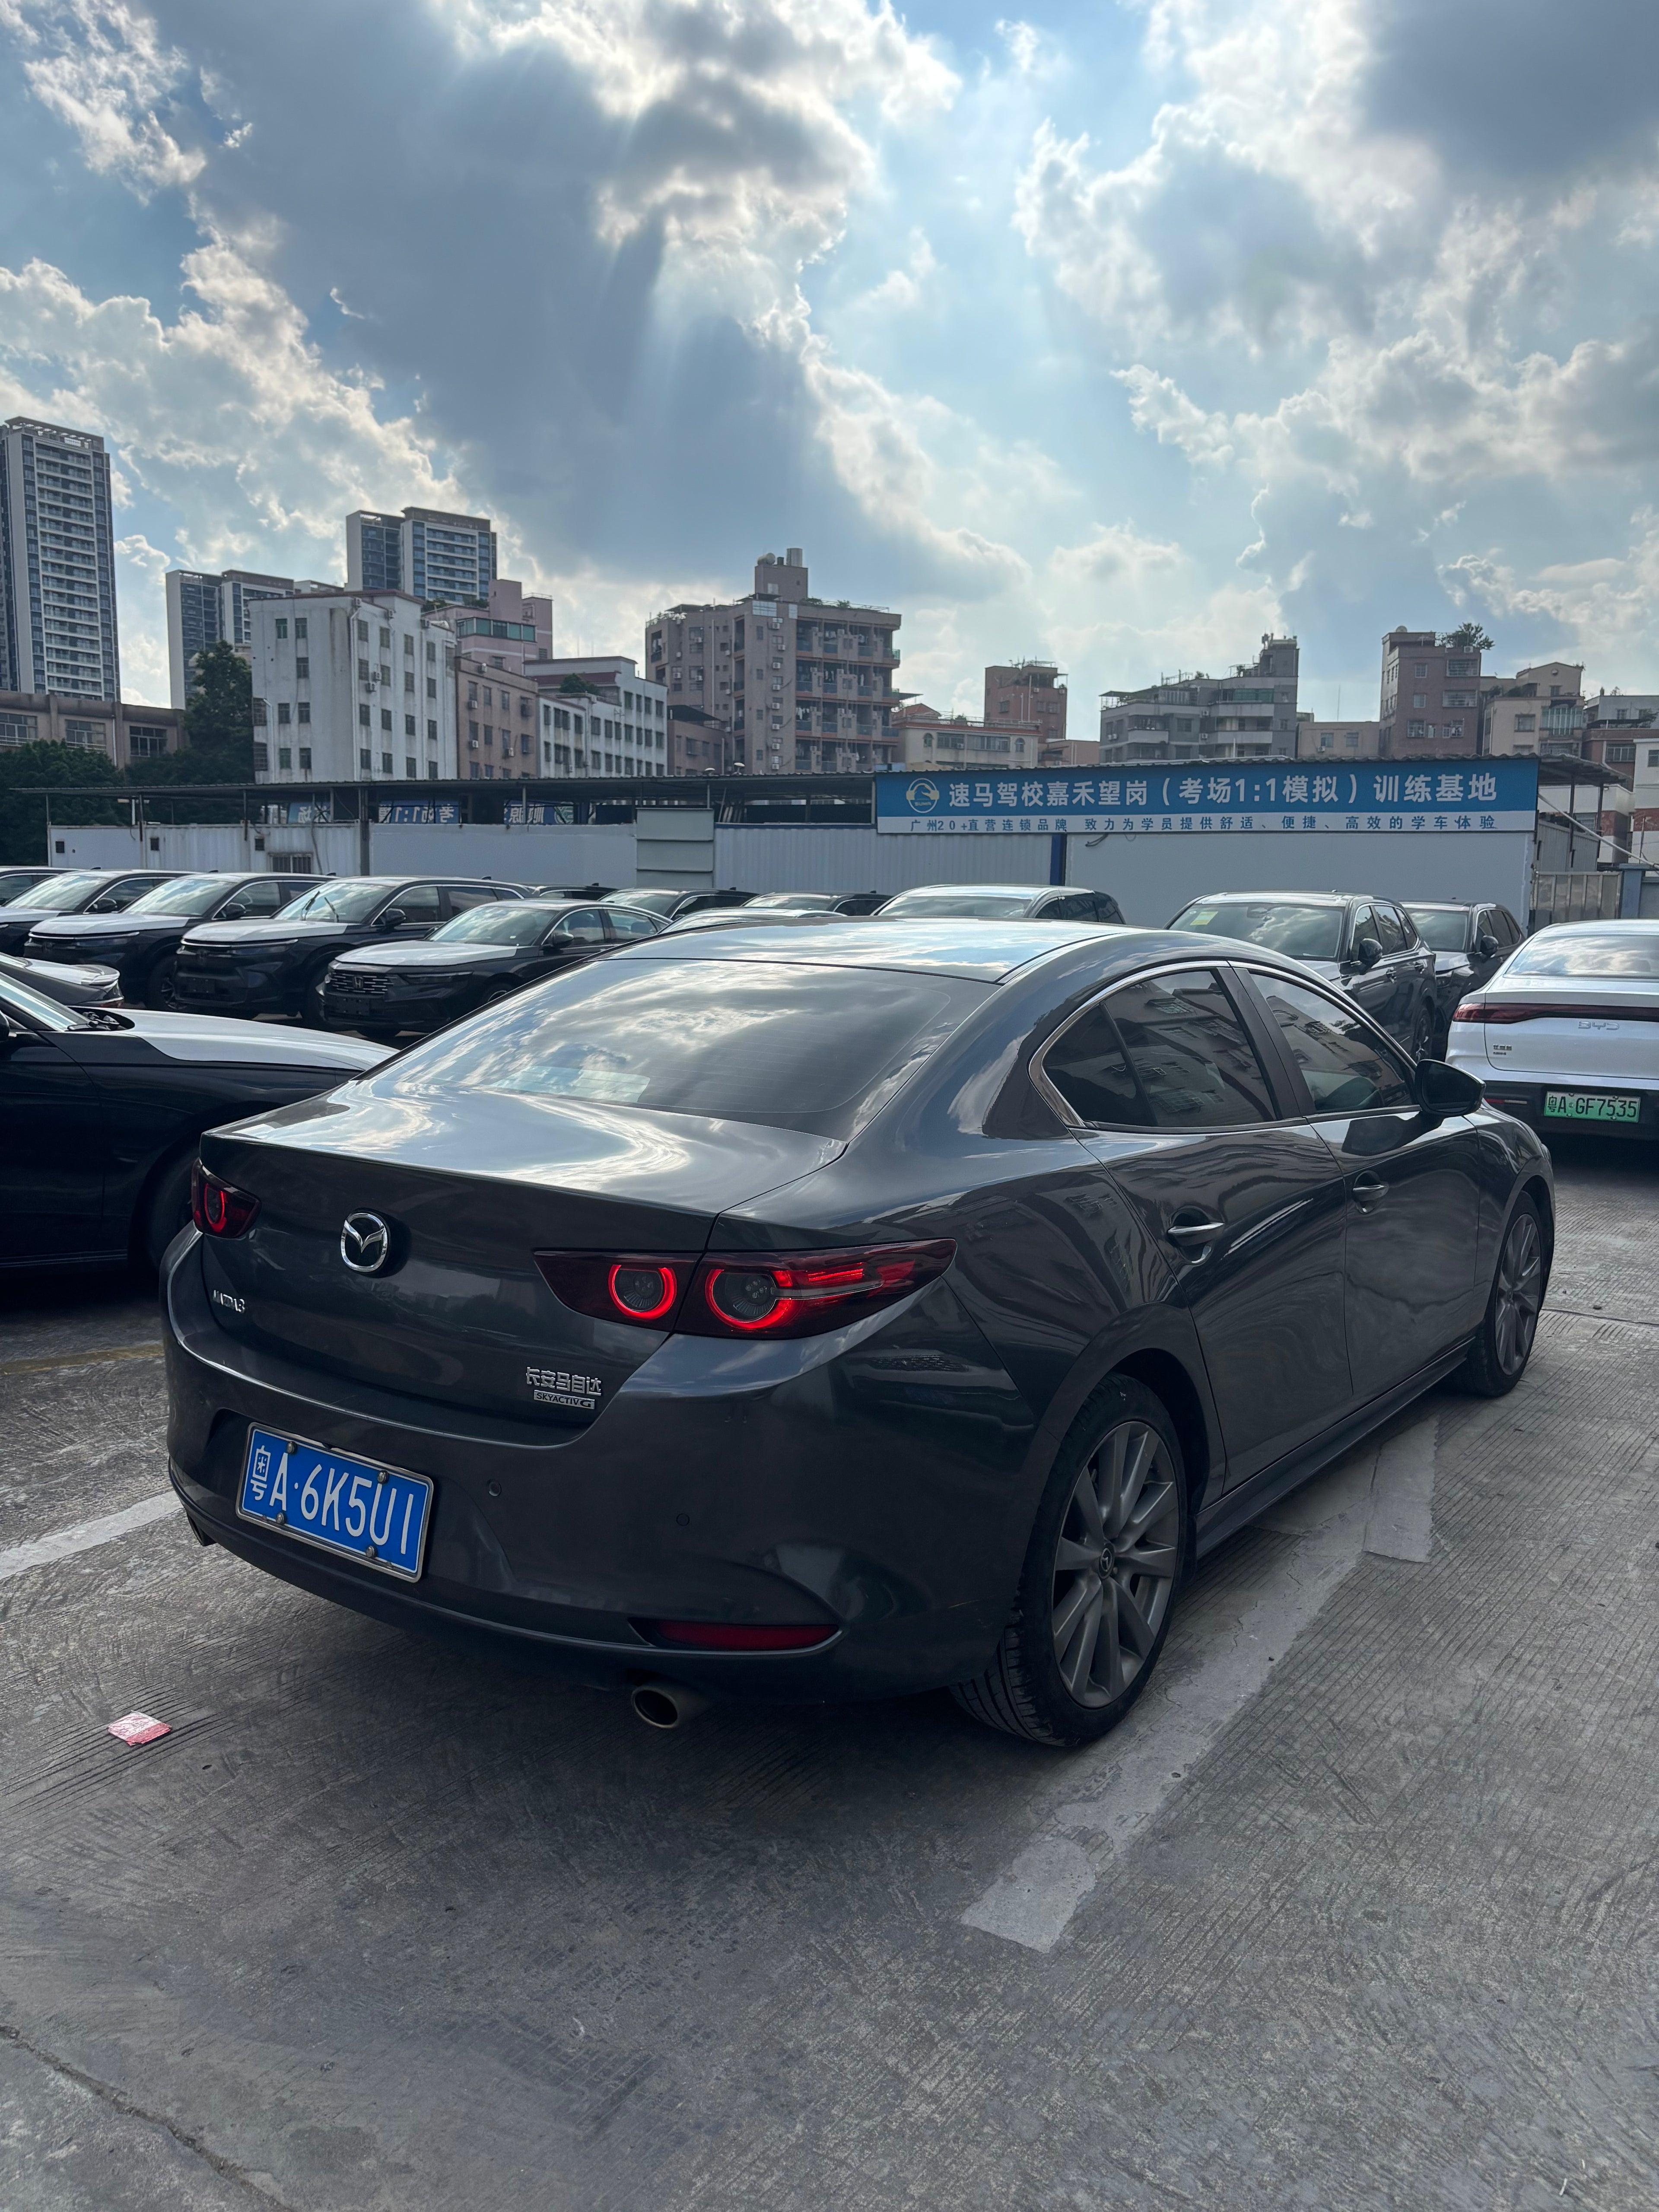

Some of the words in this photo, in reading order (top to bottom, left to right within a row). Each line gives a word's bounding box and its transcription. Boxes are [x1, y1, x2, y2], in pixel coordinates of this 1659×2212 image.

[949, 772, 1497, 808] 速马驾校嘉禾望岗（考场1:1模拟）训练基地
[910, 818, 1067, 832] 广州20+直营连锁品牌
[1578, 1021, 1620, 1030] BYD
[526, 1367, 601, 1396] 长安马自达
